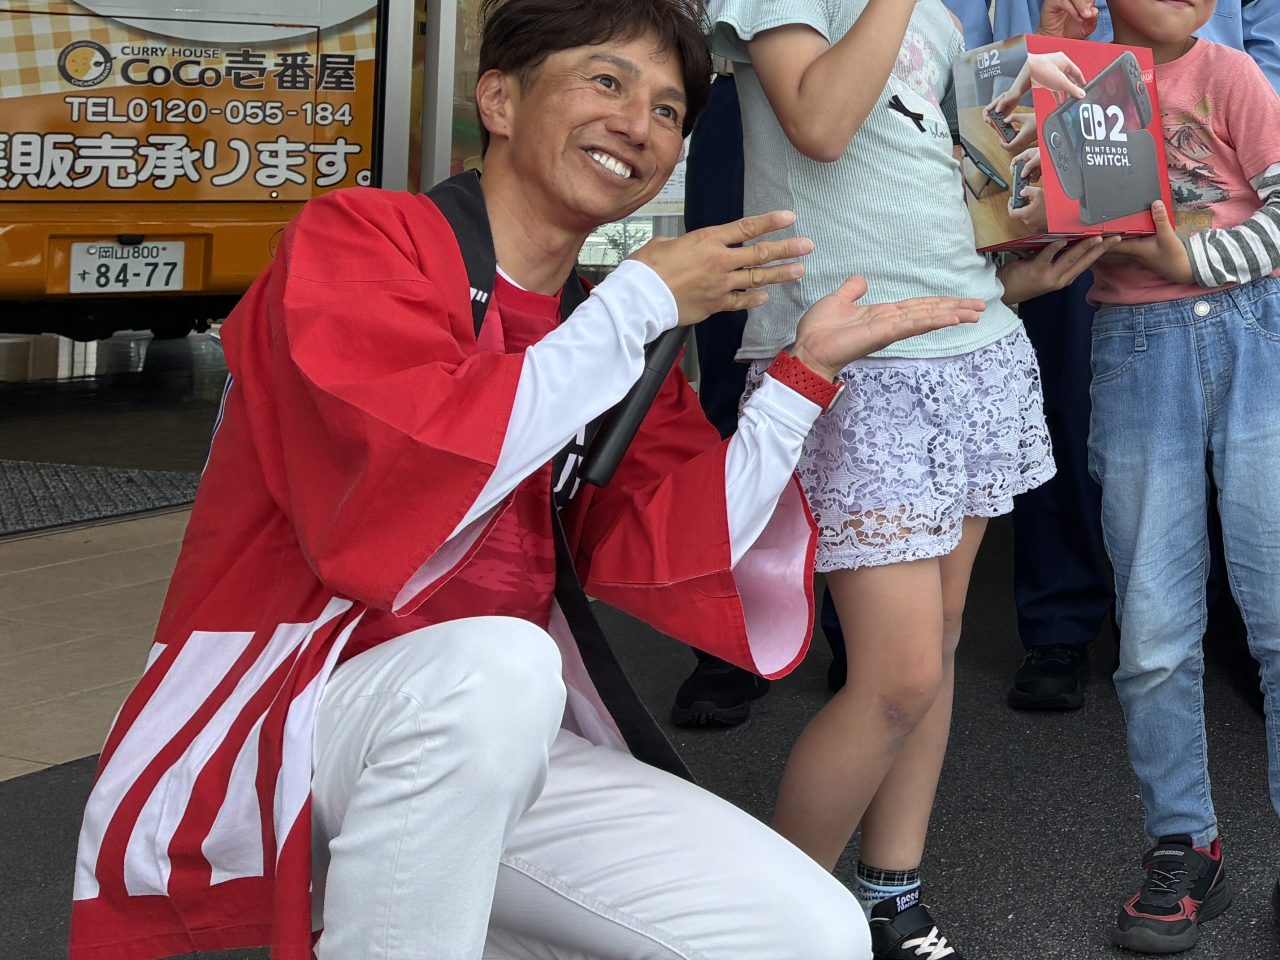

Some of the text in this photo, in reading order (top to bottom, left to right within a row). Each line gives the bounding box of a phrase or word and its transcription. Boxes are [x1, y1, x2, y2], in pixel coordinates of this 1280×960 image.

[120, 45, 220, 59] CURRY HOUSE
[1085, 145, 1128, 155] NINTENDO
[0, 132, 371, 190] 販売承ります。
[77, 261, 179, 288] す 84-77
[896, 889, 919, 907] Speed
